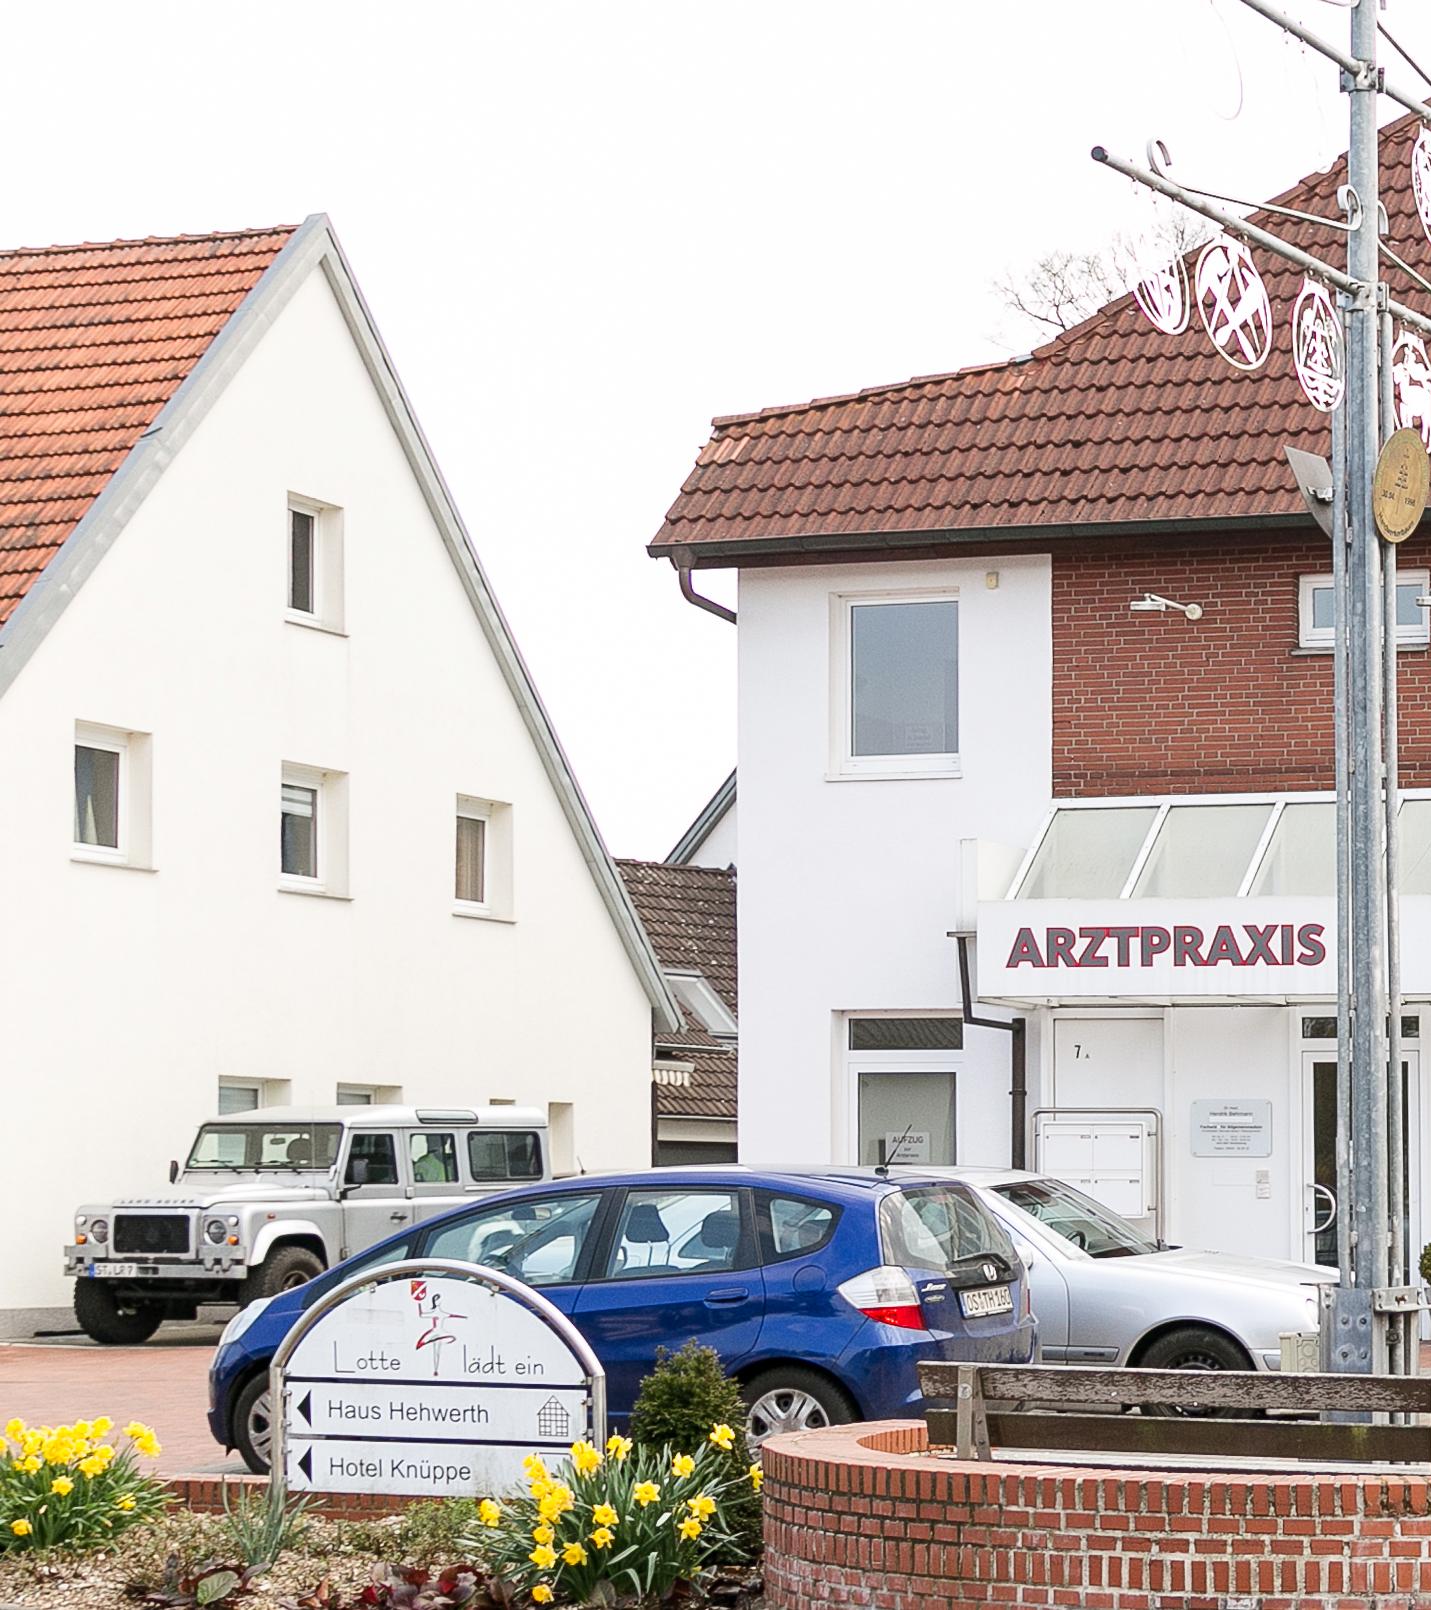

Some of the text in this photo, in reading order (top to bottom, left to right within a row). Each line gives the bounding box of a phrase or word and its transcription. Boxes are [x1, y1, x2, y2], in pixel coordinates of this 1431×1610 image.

[1005, 923, 1327, 969] ARZTPRAXIS
[1074, 1044, 1081, 1059] 7
[333, 1340, 545, 1376] Lotte lädt ein
[328, 1399, 489, 1424] Haus Hehwerth
[329, 1456, 472, 1485] Hotel Knüppe
